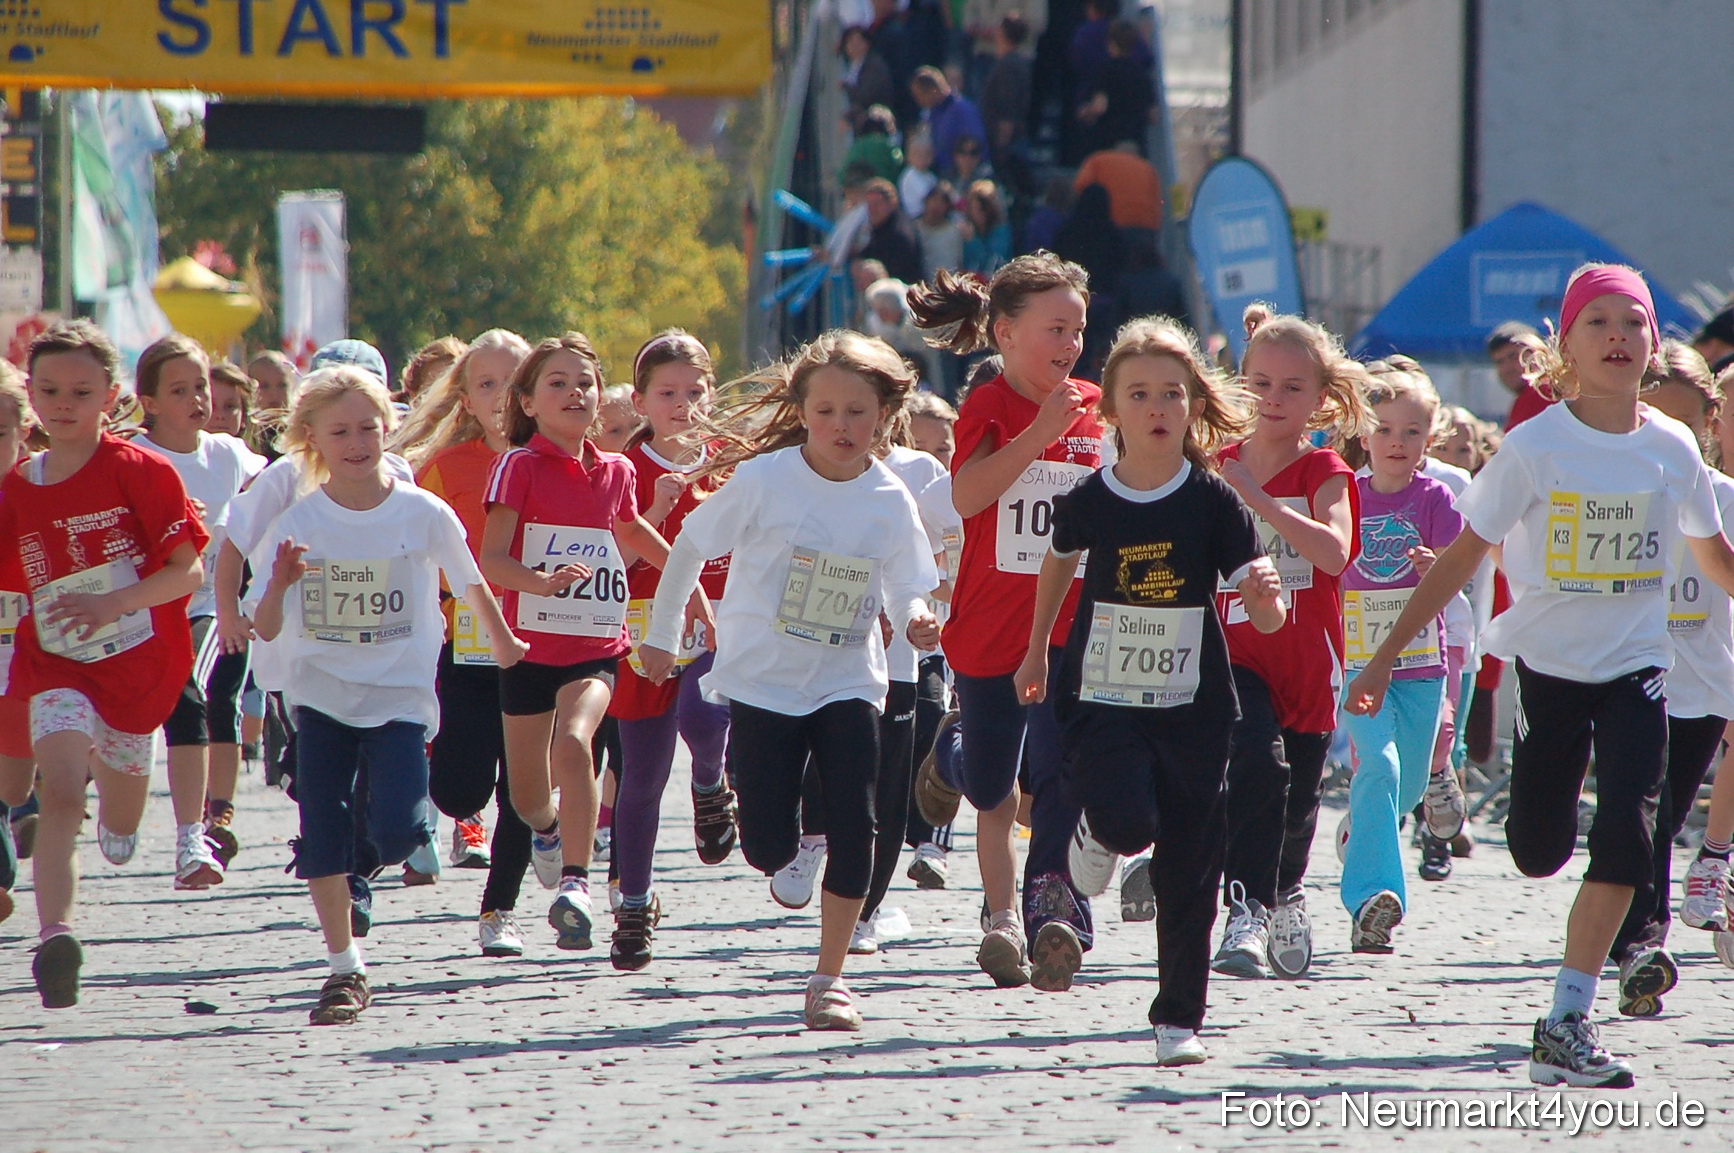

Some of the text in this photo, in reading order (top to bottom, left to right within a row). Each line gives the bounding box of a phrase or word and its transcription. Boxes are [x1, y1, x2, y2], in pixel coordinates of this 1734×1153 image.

[17, 21, 99, 38] Stadtlauf
[157, 0, 459, 58] START
[527, 32, 719, 47] Neumarkter Stadtlauf
[67, 506, 130, 527] NEUMARKTER
[1586, 500, 1634, 520] Sarah
[66, 516, 120, 535] STADTLAUF
[1554, 529, 1570, 545] K3
[545, 533, 608, 558] Lena
[1119, 543, 1172, 556] NEUMARKTER
[1586, 531, 1660, 561] 7125
[1123, 551, 1168, 563] STADTLAUF
[331, 566, 374, 582] Sarah
[820, 558, 870, 583] Luciana
[788, 579, 804, 594] K3
[1131, 579, 1185, 592] BAMBINILAUF
[1626, 576, 1663, 588] PFLEIDERER
[305, 589, 320, 602] K3
[333, 589, 405, 616] 7190
[816, 587, 877, 620] 7049
[458, 616, 471, 627] K3
[548, 612, 582, 621] PFLEIDERER
[372, 626, 412, 639] PFLEIDERER
[1119, 615, 1166, 636] Selina
[1090, 641, 1105, 656] K3
[1119, 646, 1192, 674] 7087
